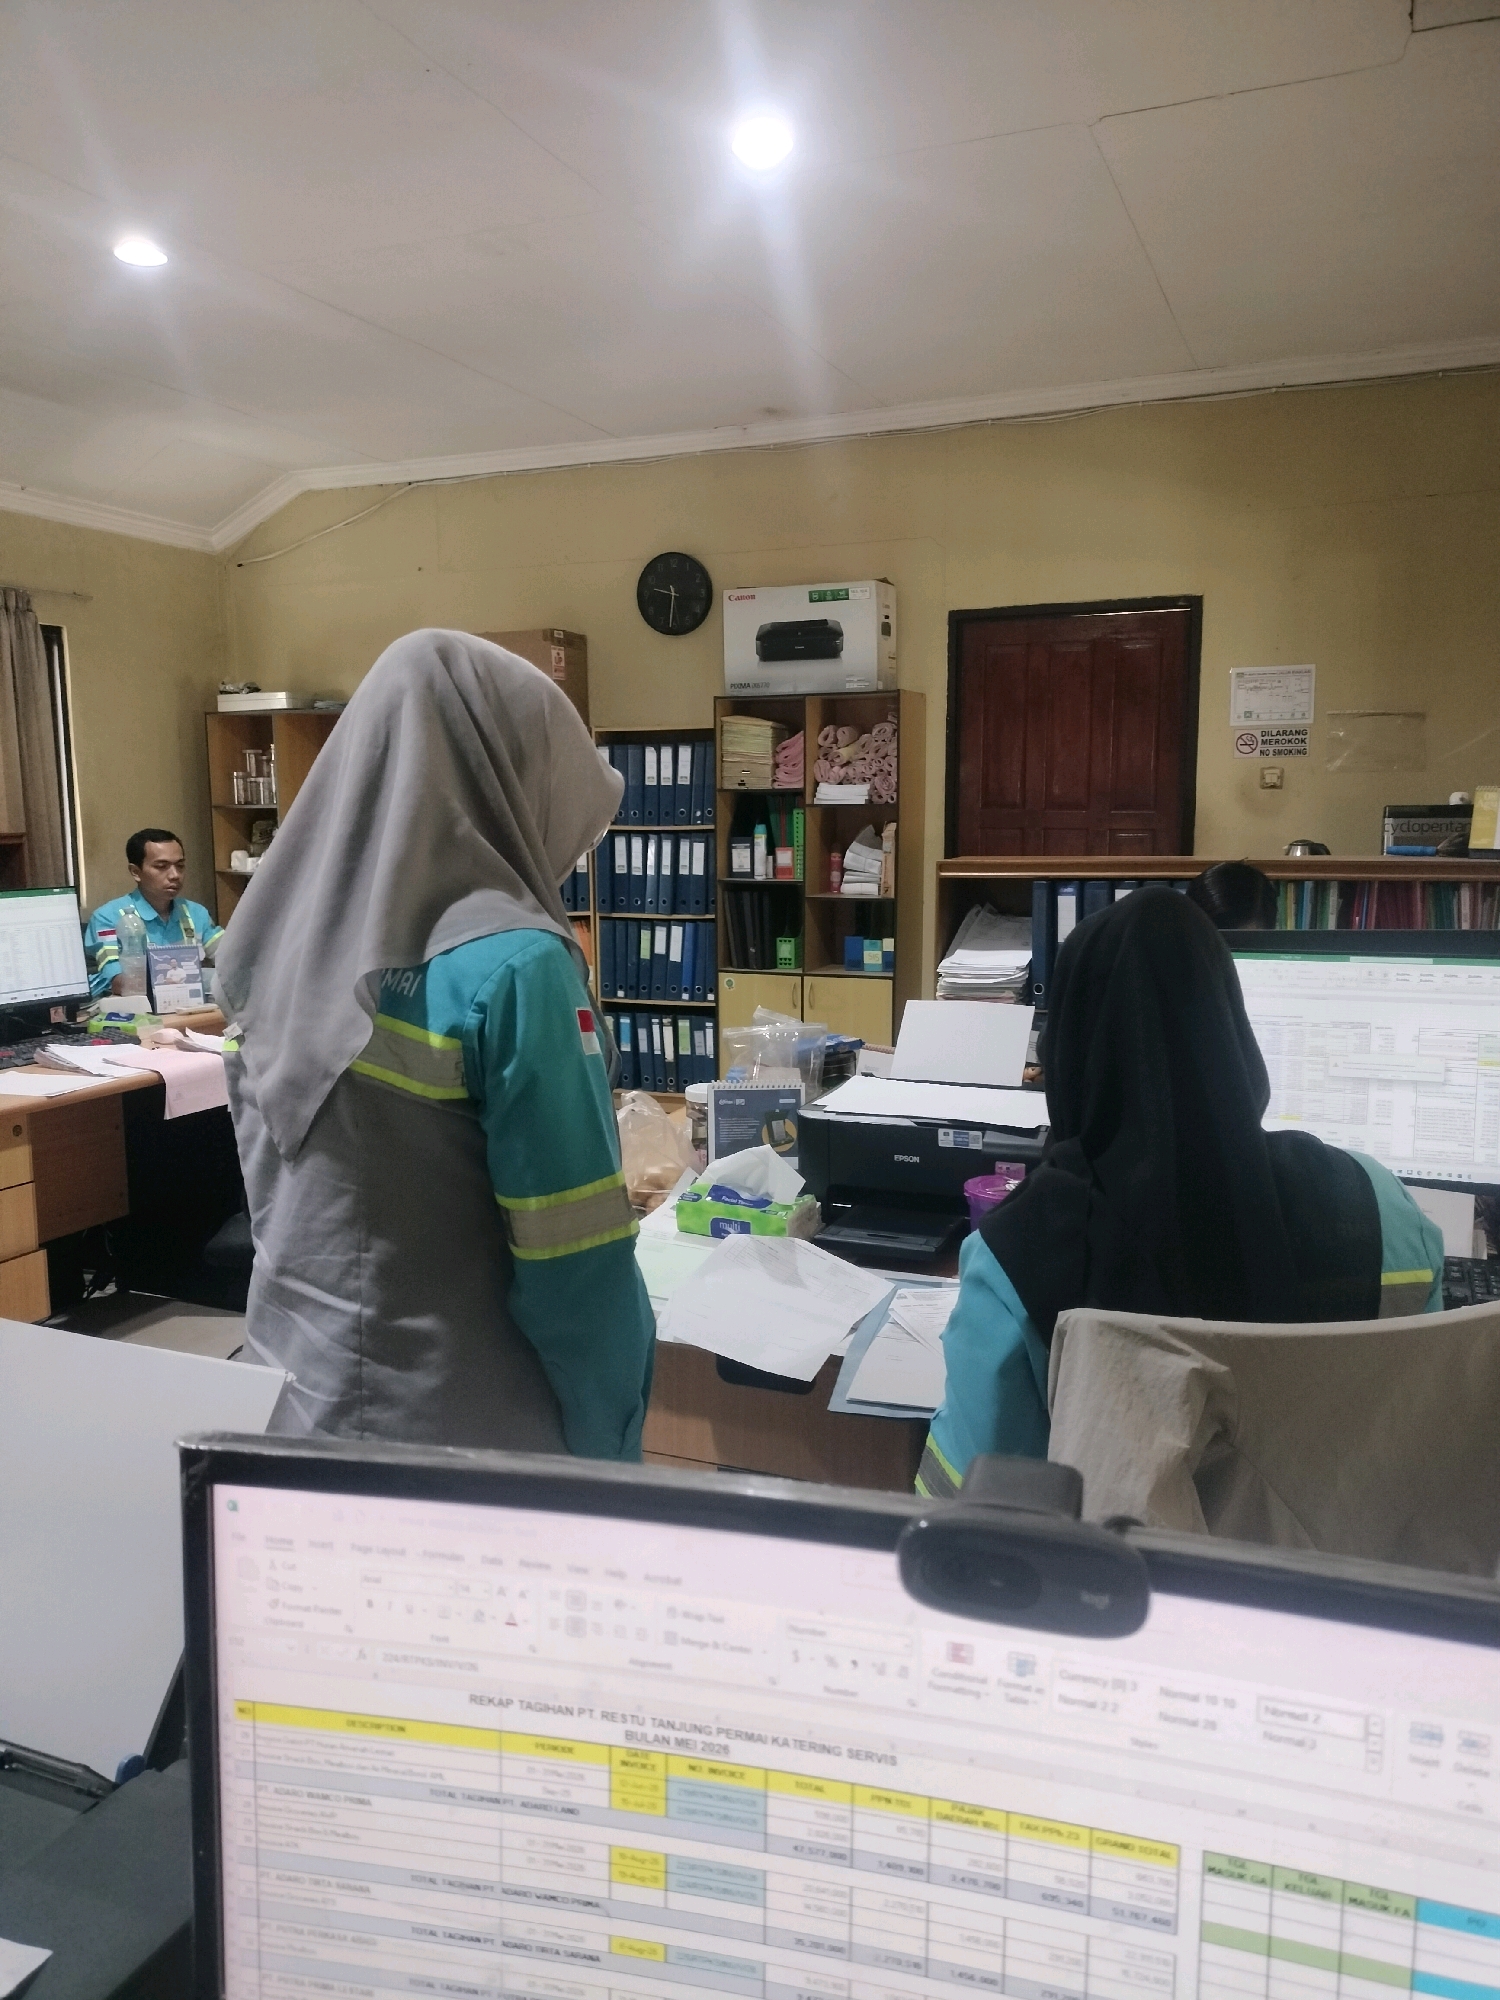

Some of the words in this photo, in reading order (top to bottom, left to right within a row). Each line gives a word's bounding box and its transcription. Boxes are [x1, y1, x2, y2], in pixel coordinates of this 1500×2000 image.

[728, 594, 757, 602] Canon
[730, 682, 751, 690] PIXMA
[1260, 728, 1308, 738] DILARANG
[1260, 737, 1308, 746] MEROKOK
[1259, 749, 1271, 757] NO
[1272, 747, 1308, 757] SMOKING
[381, 967, 423, 998] MAI
[894, 1154, 920, 1164] EPSON
[719, 1220, 741, 1231] multi
[264, 1534, 295, 1547] Home
[1059, 1668, 1109, 1689] Currency
[1158, 1684, 1201, 1704] Normal
[1157, 1709, 1200, 1729] Normal
[1263, 1703, 1308, 1723] Normal
[345, 1718, 407, 1734] DESCRIPTION
[468, 1693, 514, 1710] REKAP
[518, 1699, 575, 1718] TAGIHAN
[600, 1708, 647, 1728] RESTU
[650, 1717, 713, 1738] TANJUNG
[716, 1726, 769, 1746] PERMAI
[846, 1747, 899, 1768] SERVIS
[624, 1728, 671, 1747] BULAN
[674, 1734, 698, 1752] MEI
[701, 1739, 731, 1756] 2026
[619, 1758, 657, 1773] INVOICE
[707, 1766, 747, 1781] INVOICE
